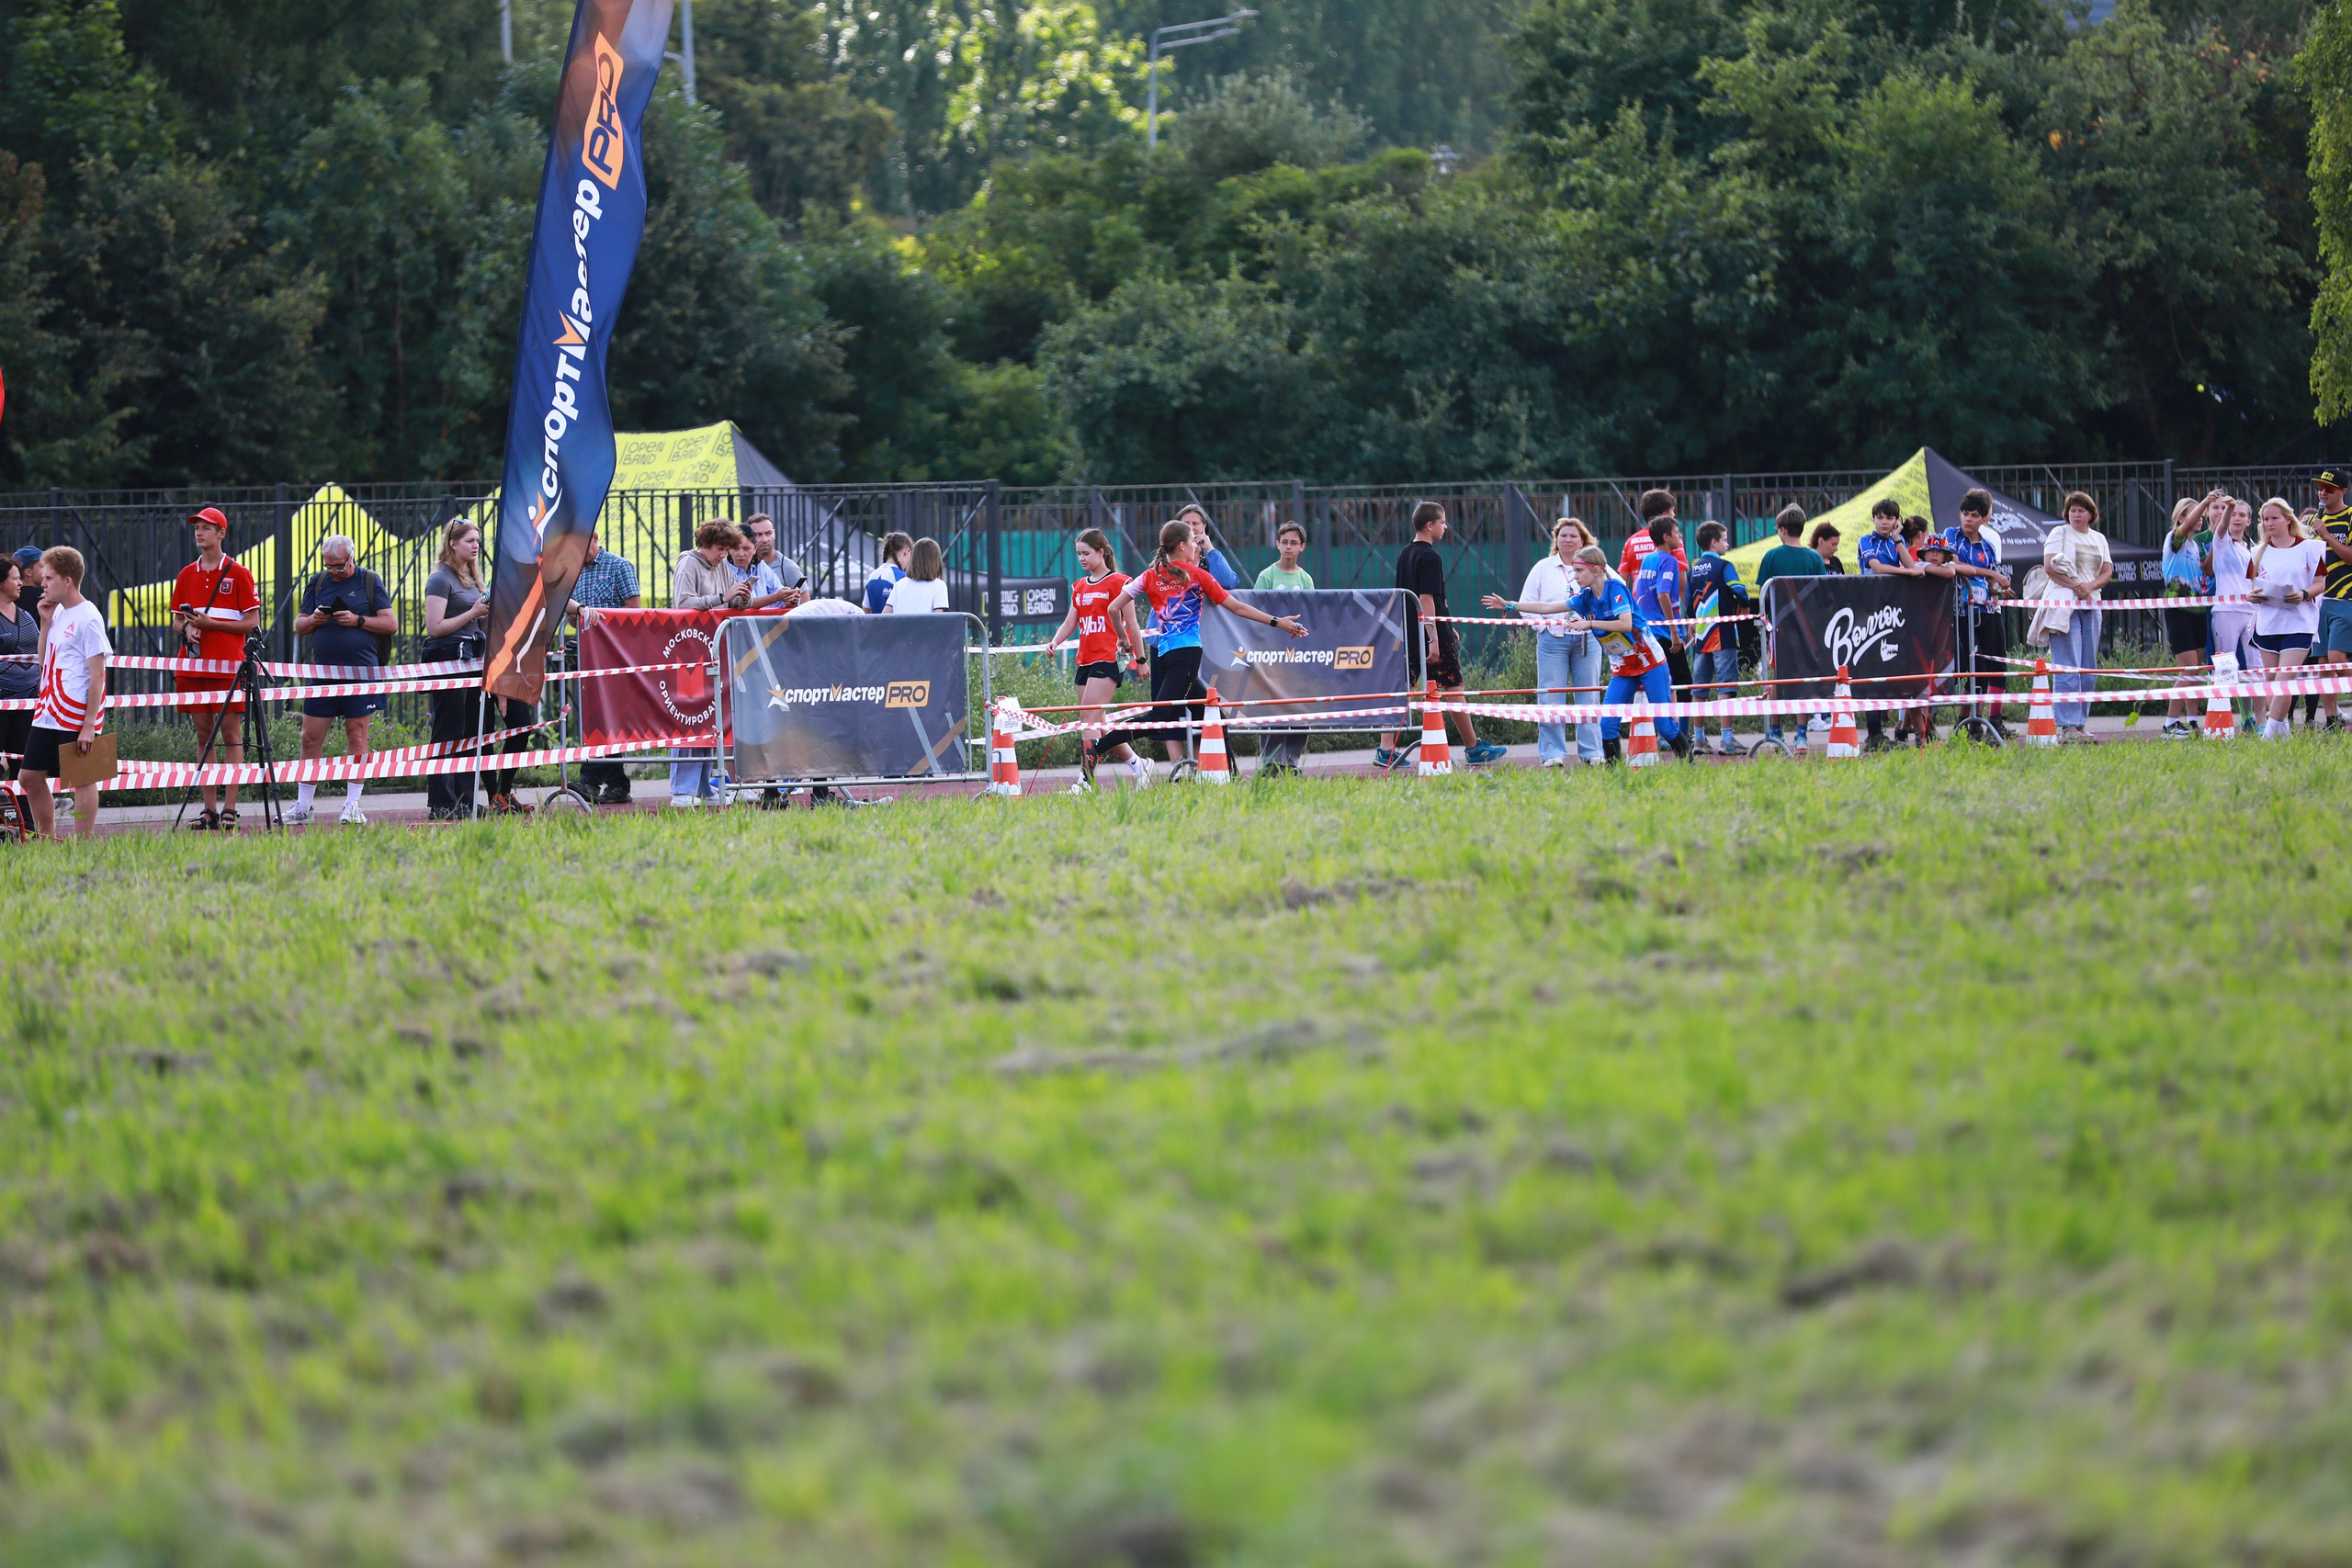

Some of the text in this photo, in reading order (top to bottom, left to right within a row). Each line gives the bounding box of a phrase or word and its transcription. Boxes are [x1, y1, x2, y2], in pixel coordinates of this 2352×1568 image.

[588, 52, 619, 176] PRO
[628, 441, 666, 453] OPEN
[622, 453, 657, 465] BAND
[1026, 588, 1057, 603] OPEN
[1026, 602, 1054, 615] BAND
[662, 628, 715, 659] МОСКОВСКО
[1336, 650, 1371, 666] PRO
[888, 685, 927, 704] PRO
[659, 680, 716, 726] ОРИЕНТИРОВА
